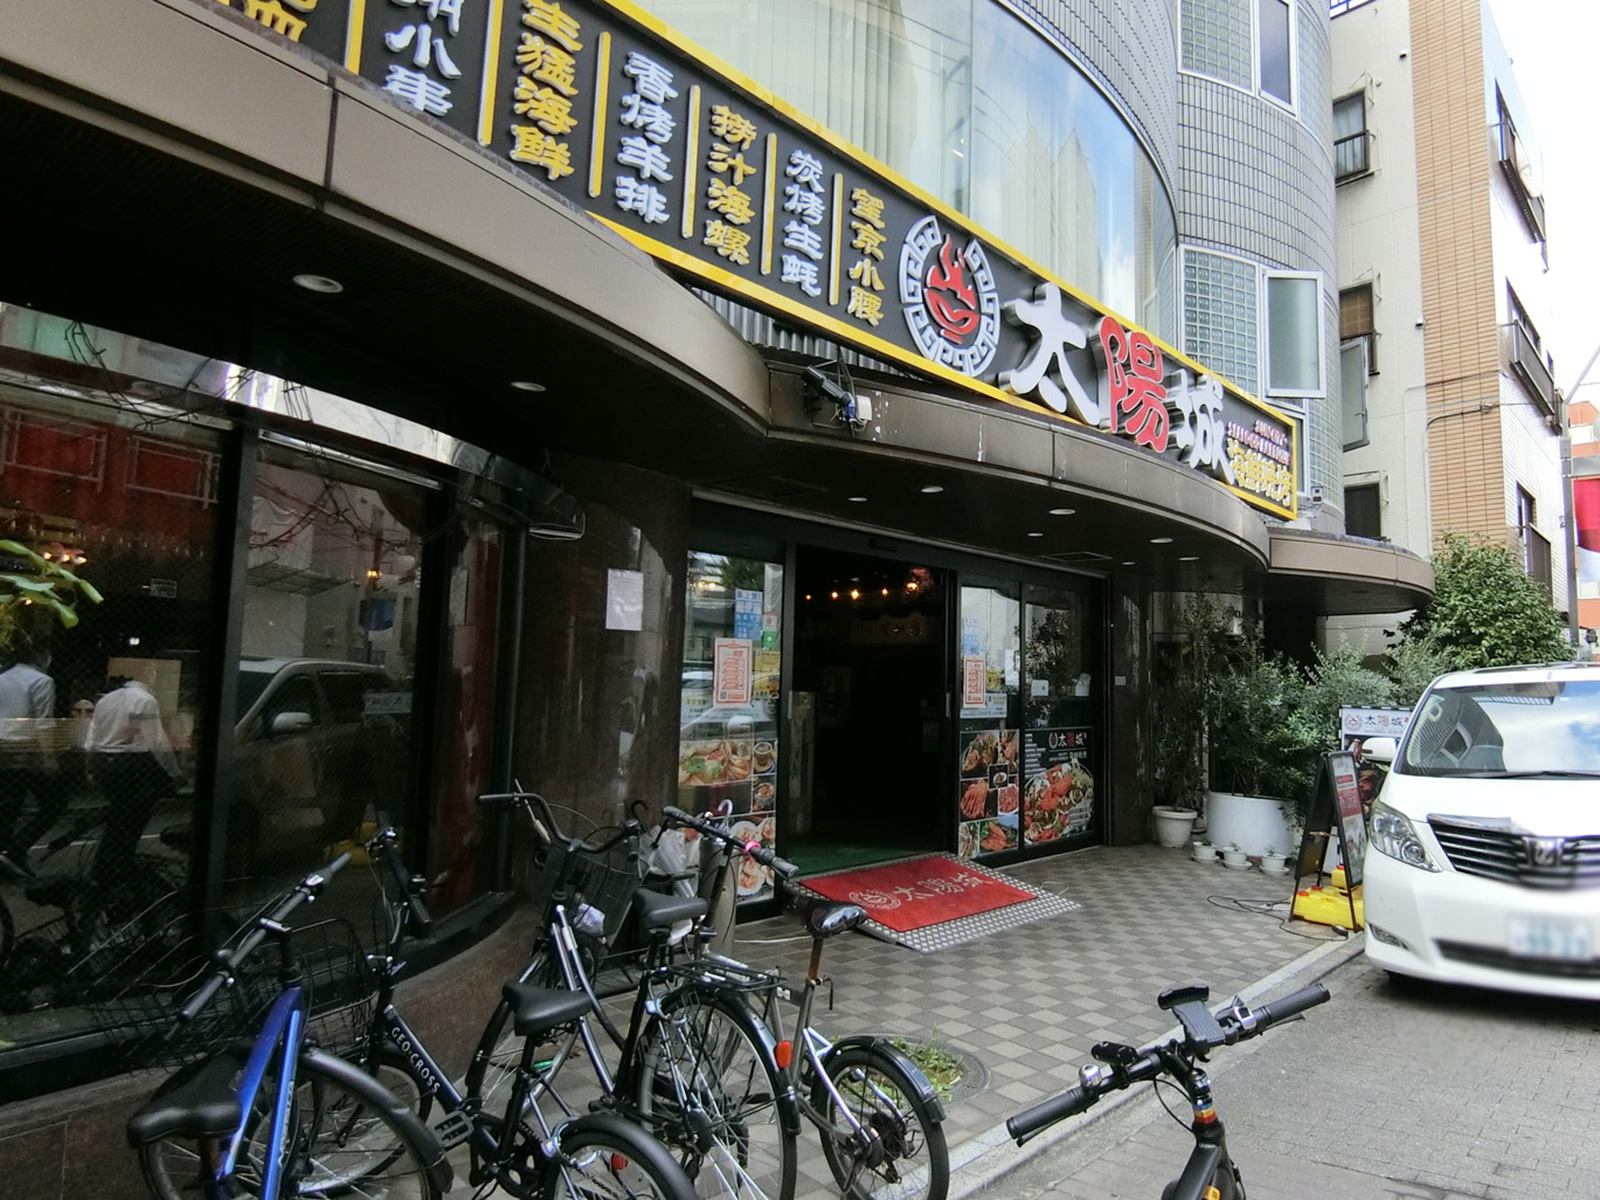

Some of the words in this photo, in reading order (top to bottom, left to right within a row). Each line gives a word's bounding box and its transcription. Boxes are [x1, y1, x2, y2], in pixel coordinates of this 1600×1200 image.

[615, 51, 678, 224] 香烤羊排
[847, 188, 887, 327] 望京小腰
[1002, 281, 1235, 485] 太陽城
[894, 872, 993, 901] 太陽城
